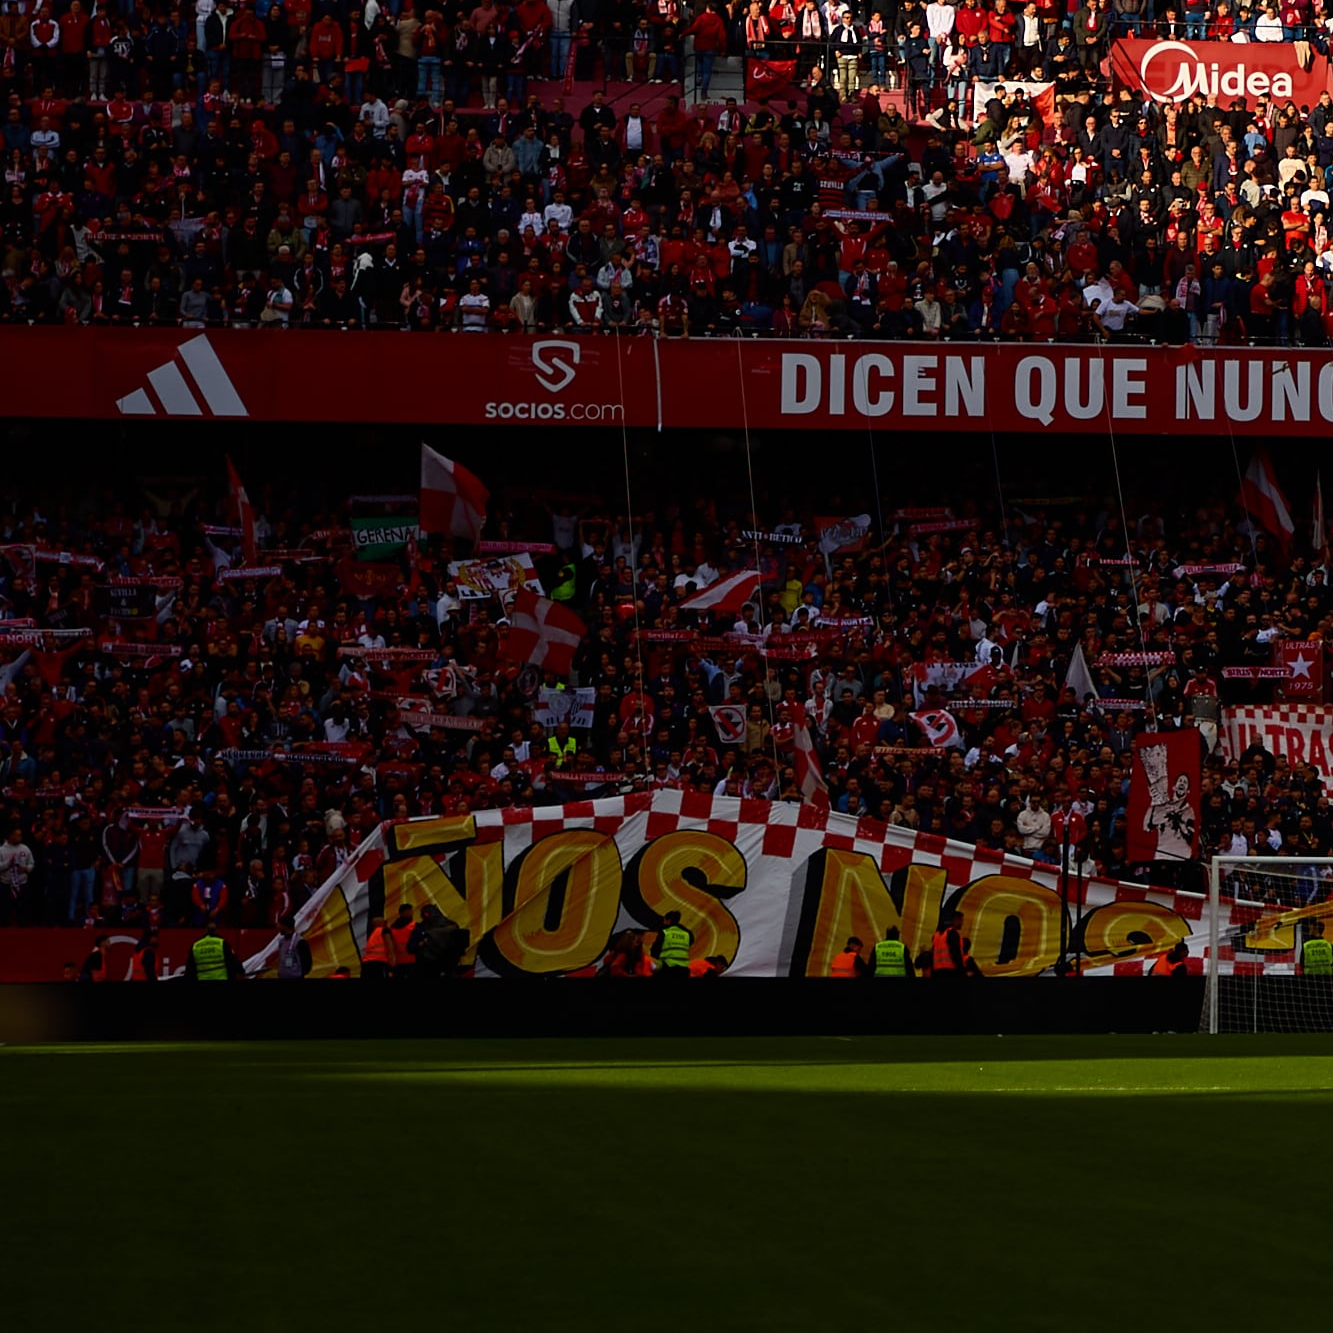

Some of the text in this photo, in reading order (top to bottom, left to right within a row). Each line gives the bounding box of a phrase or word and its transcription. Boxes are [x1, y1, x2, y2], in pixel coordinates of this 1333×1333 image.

[1163, 62, 1293, 97] Midea
[781, 354, 985, 417] DICEN
[1015, 356, 1147, 427] QUE
[355, 524, 415, 547] GERENA
[1284, 641, 1316, 650] ULTRAS
[1226, 667, 1251, 678] BIRIS
[1287, 681, 1314, 691] 1975
[304, 815, 748, 974] ÑOS
